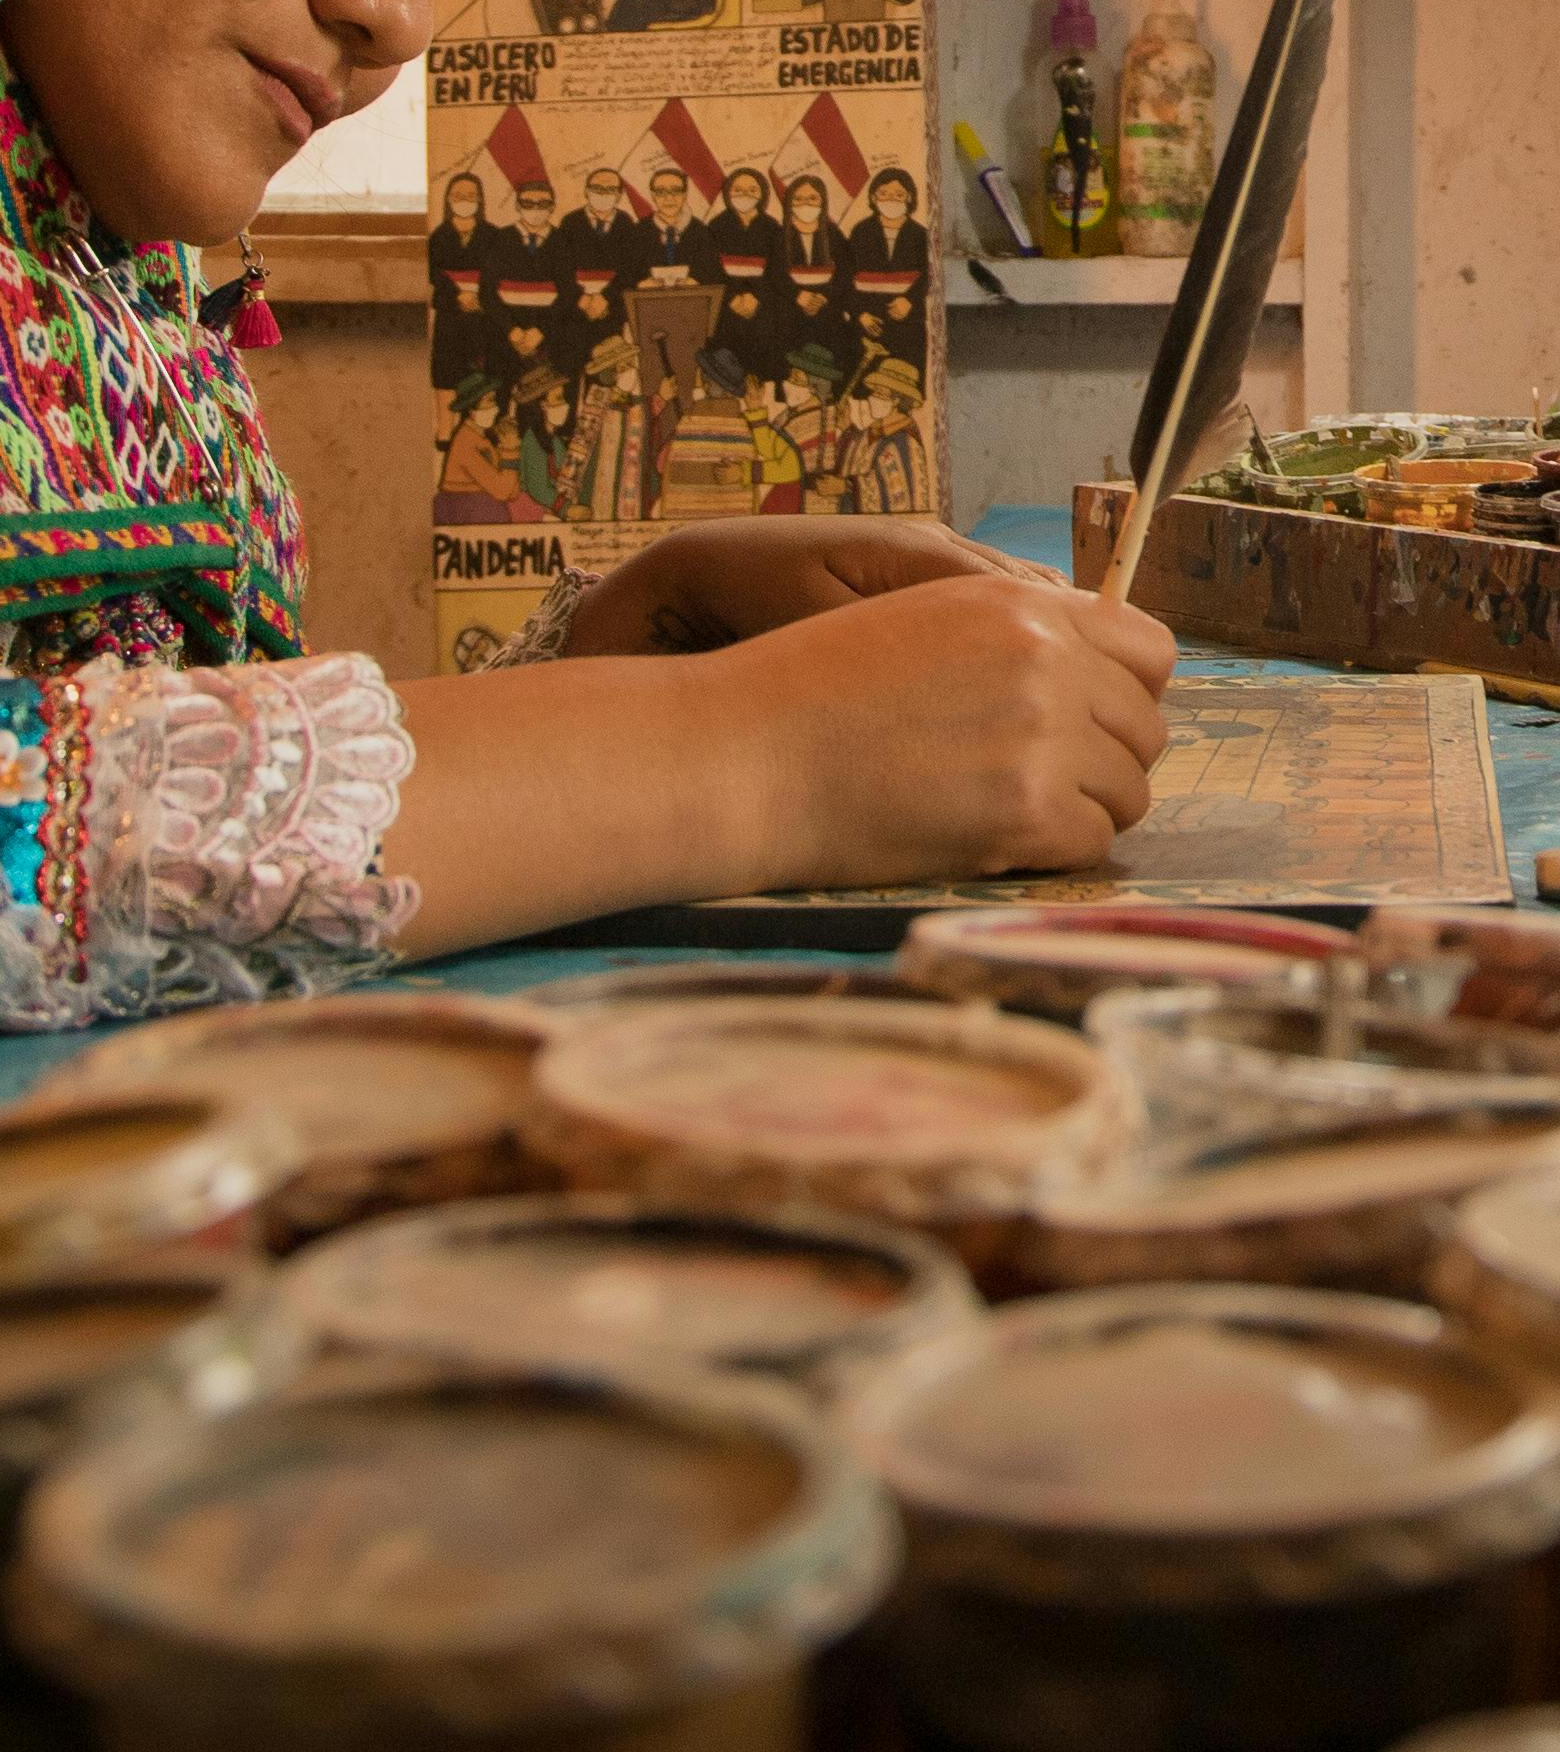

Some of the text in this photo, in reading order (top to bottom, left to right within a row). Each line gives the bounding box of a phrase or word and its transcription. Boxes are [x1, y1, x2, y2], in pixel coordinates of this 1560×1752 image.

[779, 23, 921, 55] ESTADO DE
[777, 56, 921, 88] EMERGENCIA
[434, 75, 471, 104] EN
[432, 532, 567, 581] PANDEMIA
